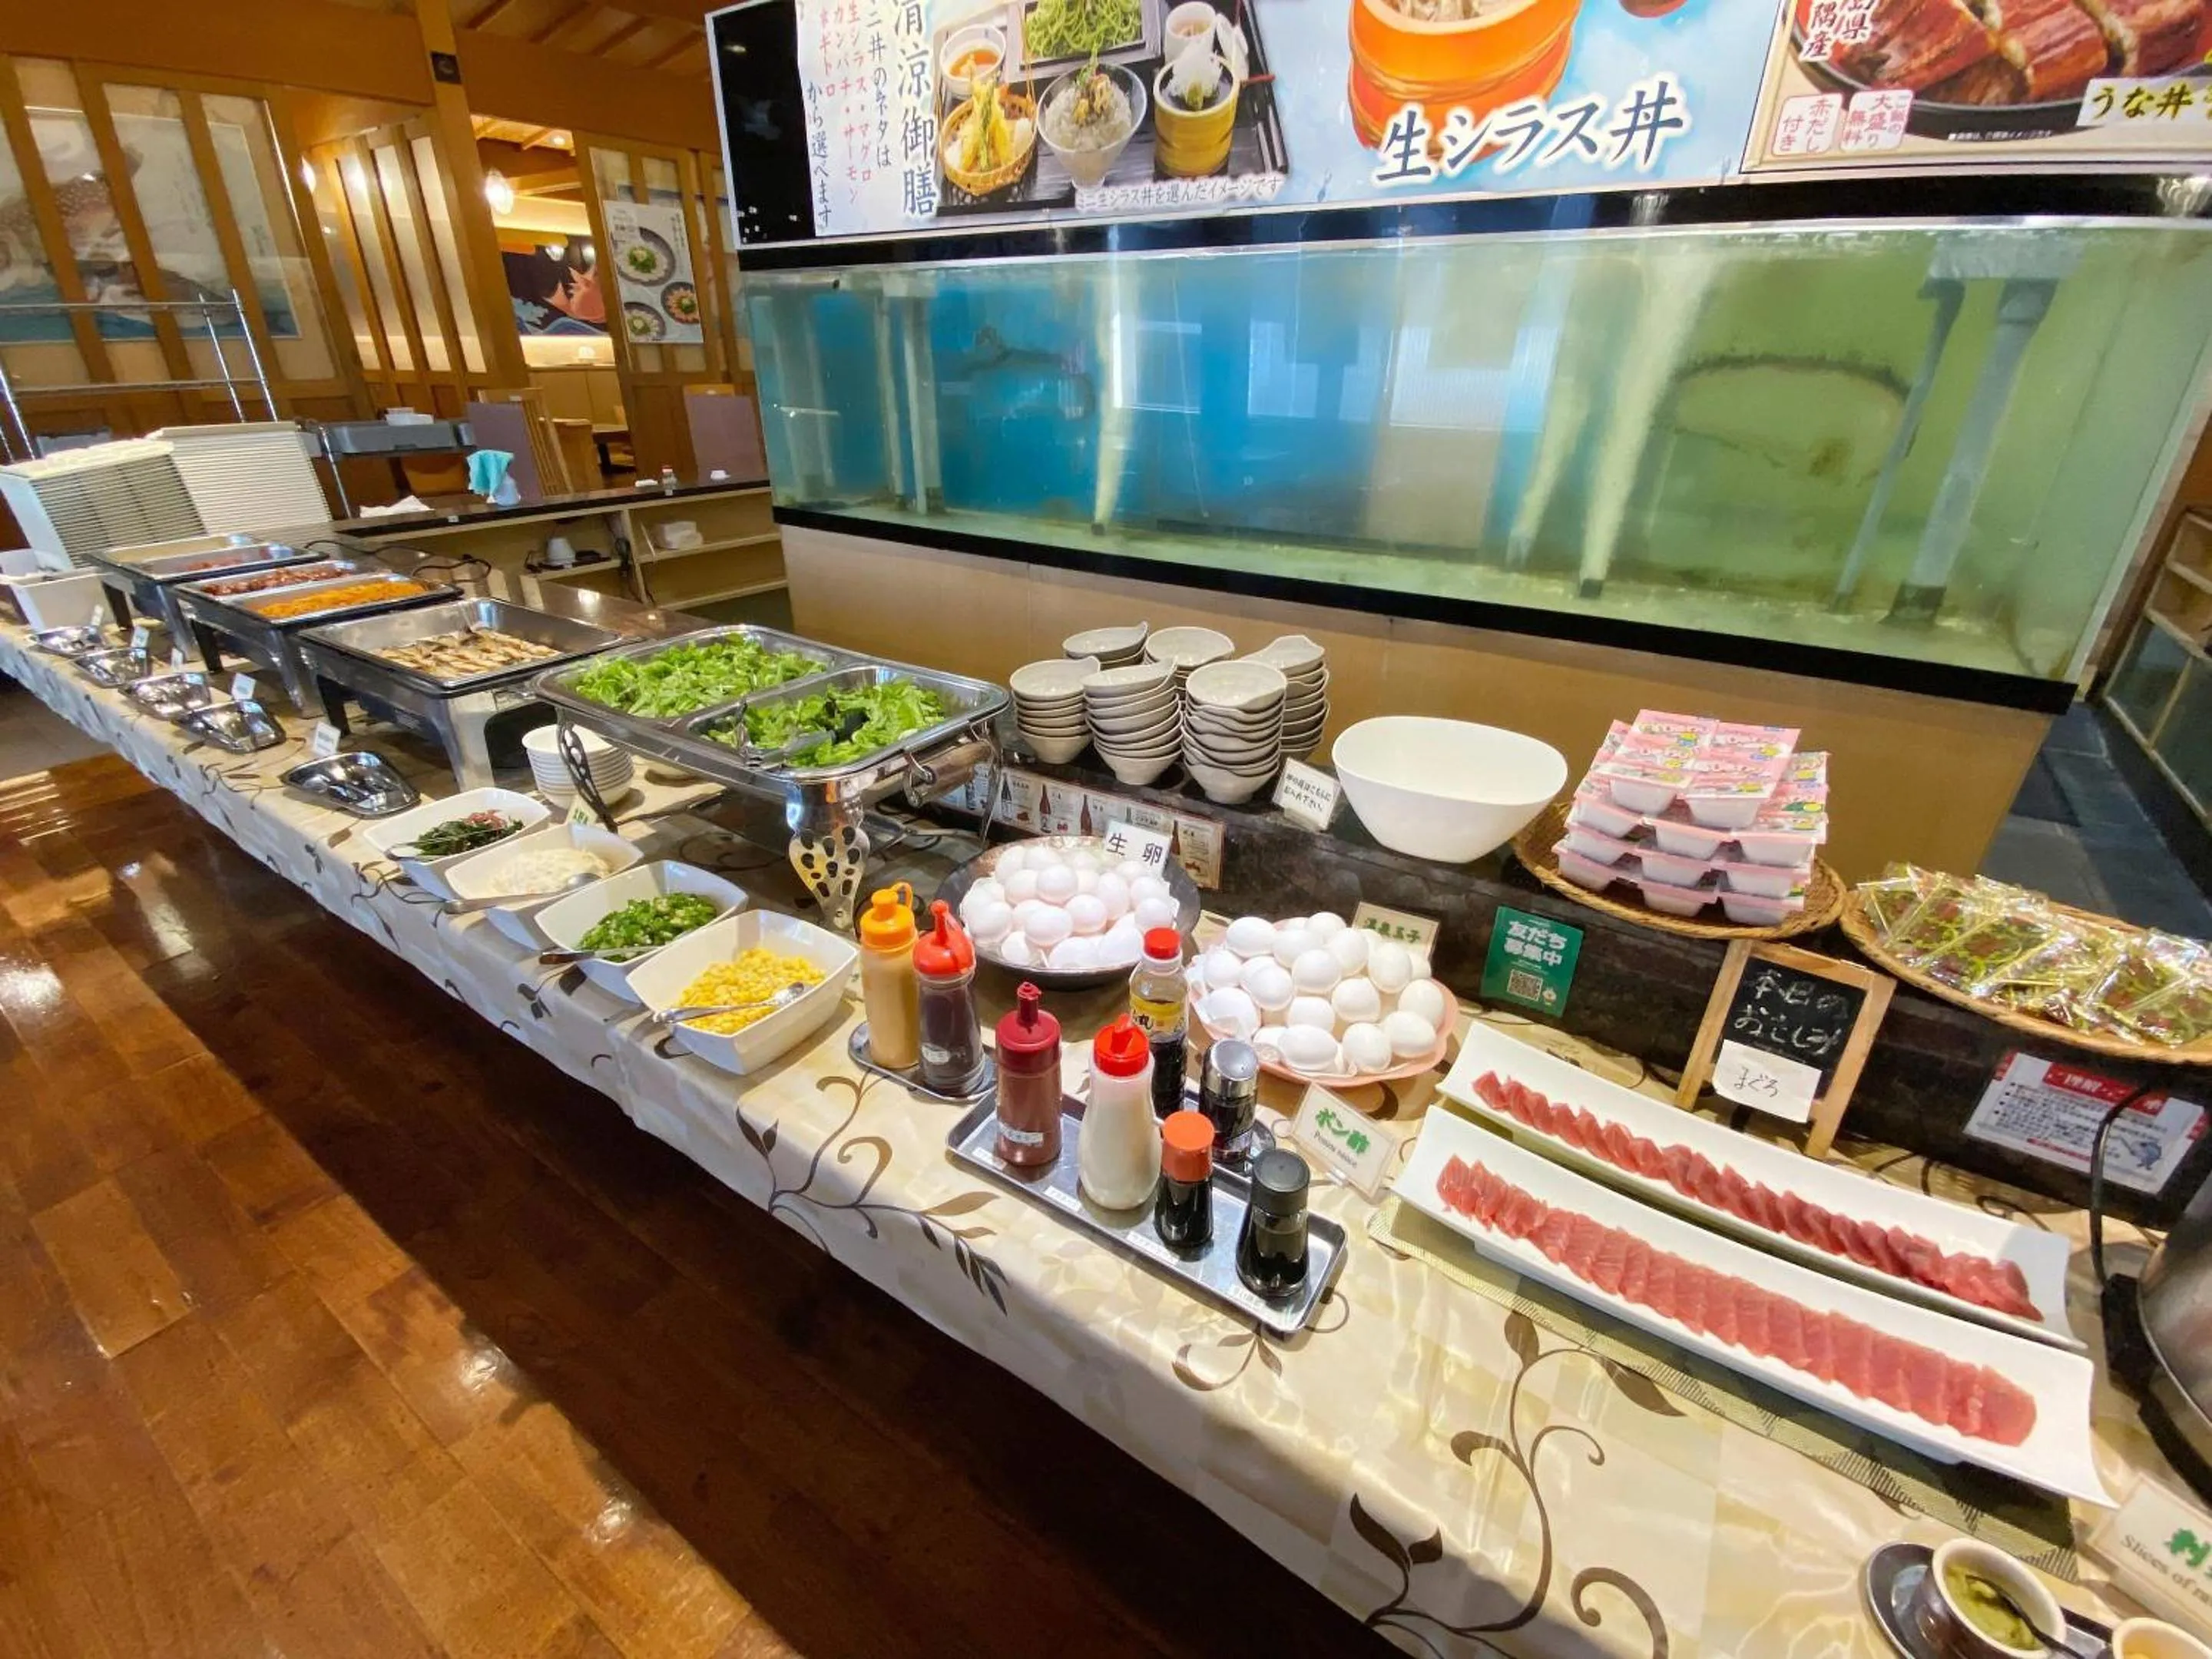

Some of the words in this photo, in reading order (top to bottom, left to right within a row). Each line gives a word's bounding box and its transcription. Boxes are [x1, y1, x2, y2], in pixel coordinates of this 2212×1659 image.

[866, 0, 891, 168] ニ丼のネタは
[892, 0, 936, 214] 清涼御膳
[2091, 83, 2212, 121] うな丼
[1376, 81, 1684, 182] 生シラス丼
[1779, 115, 1803, 152] 付き
[1806, 98, 1834, 152] 赤だし
[806, 81, 832, 228] から選べます
[1507, 920, 1568, 950] 友だち
[1734, 1066, 1779, 1098] まぐろ
[1314, 1107, 1371, 1154] ポン酢
[2120, 1534, 2170, 1575] Slices
[2171, 1572, 2197, 1589] of
